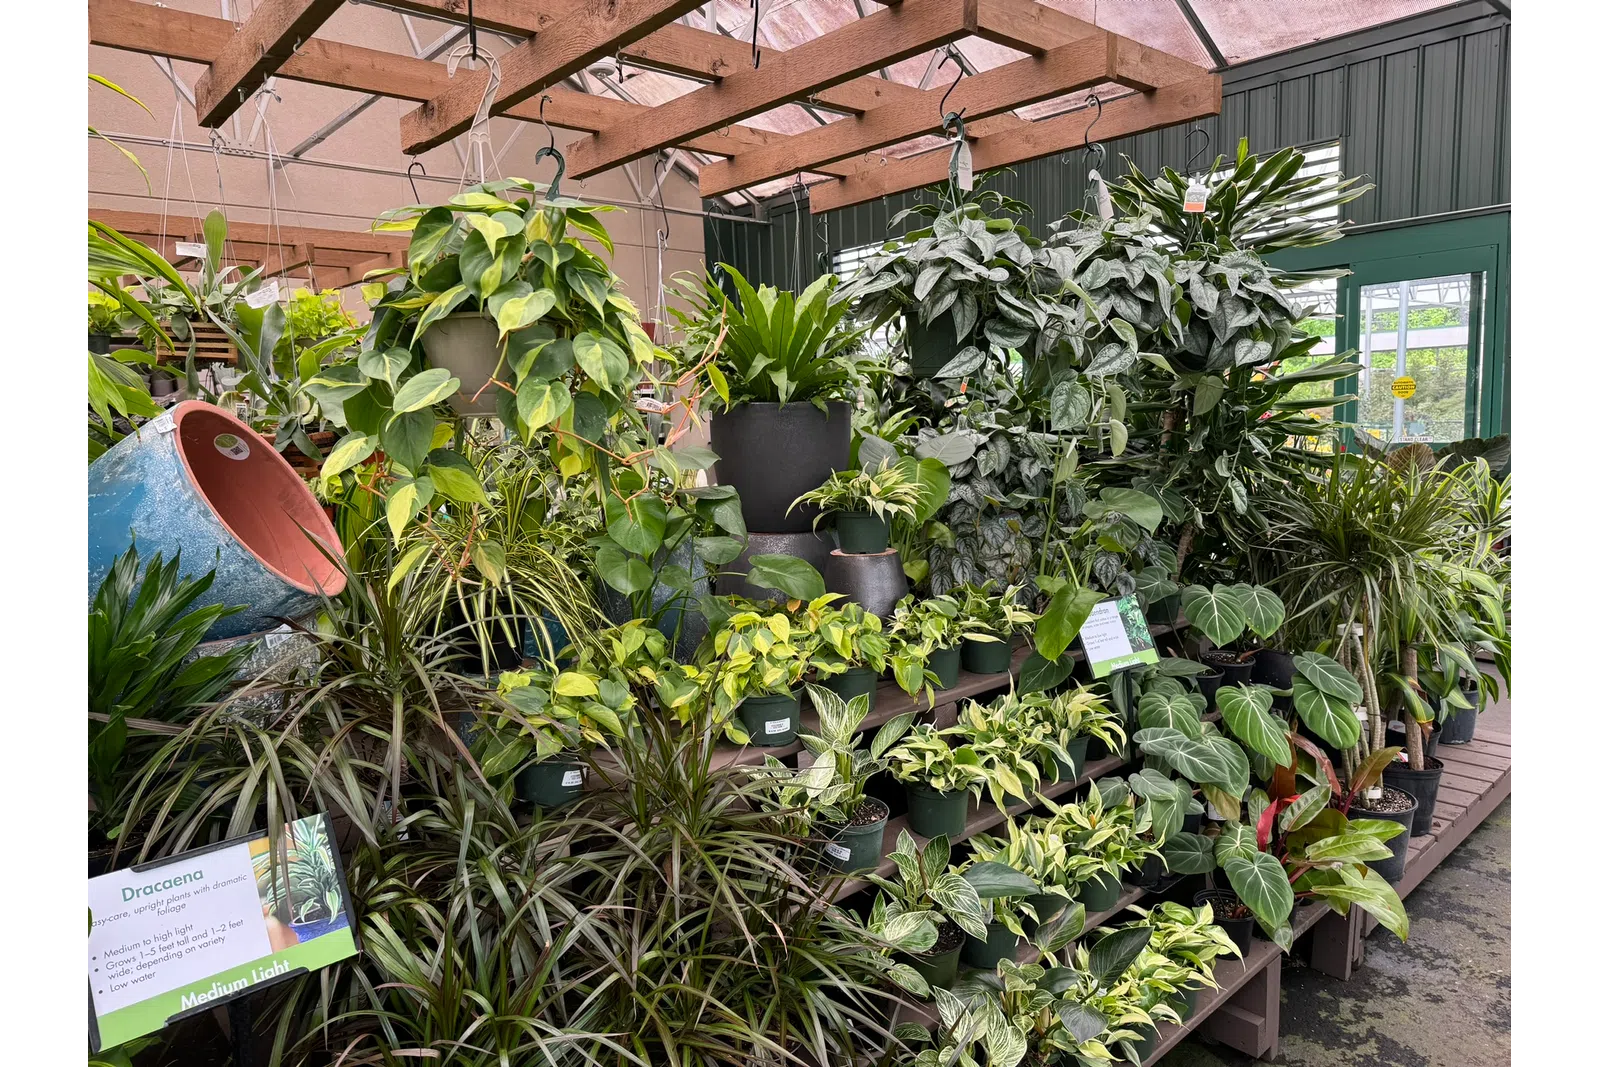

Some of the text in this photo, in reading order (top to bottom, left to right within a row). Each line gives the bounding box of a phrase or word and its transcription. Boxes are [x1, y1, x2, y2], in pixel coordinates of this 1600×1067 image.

[91, 874, 247, 927] asy-care, upright plants with dramatic
[121, 870, 204, 902] Dracaena
[157, 903, 186, 916] foliage
[103, 924, 193, 959] Medium to high light
[105, 956, 137, 970] Grows
[158, 942, 175, 953] feet
[177, 935, 190, 947] tall
[191, 929, 208, 942] and
[228, 919, 244, 929] feet
[136, 950, 183, 970] depending
[185, 946, 196, 954] on
[198, 935, 226, 949] variety
[109, 971, 156, 993] Low water
[181, 959, 291, 1011] Medium Light
